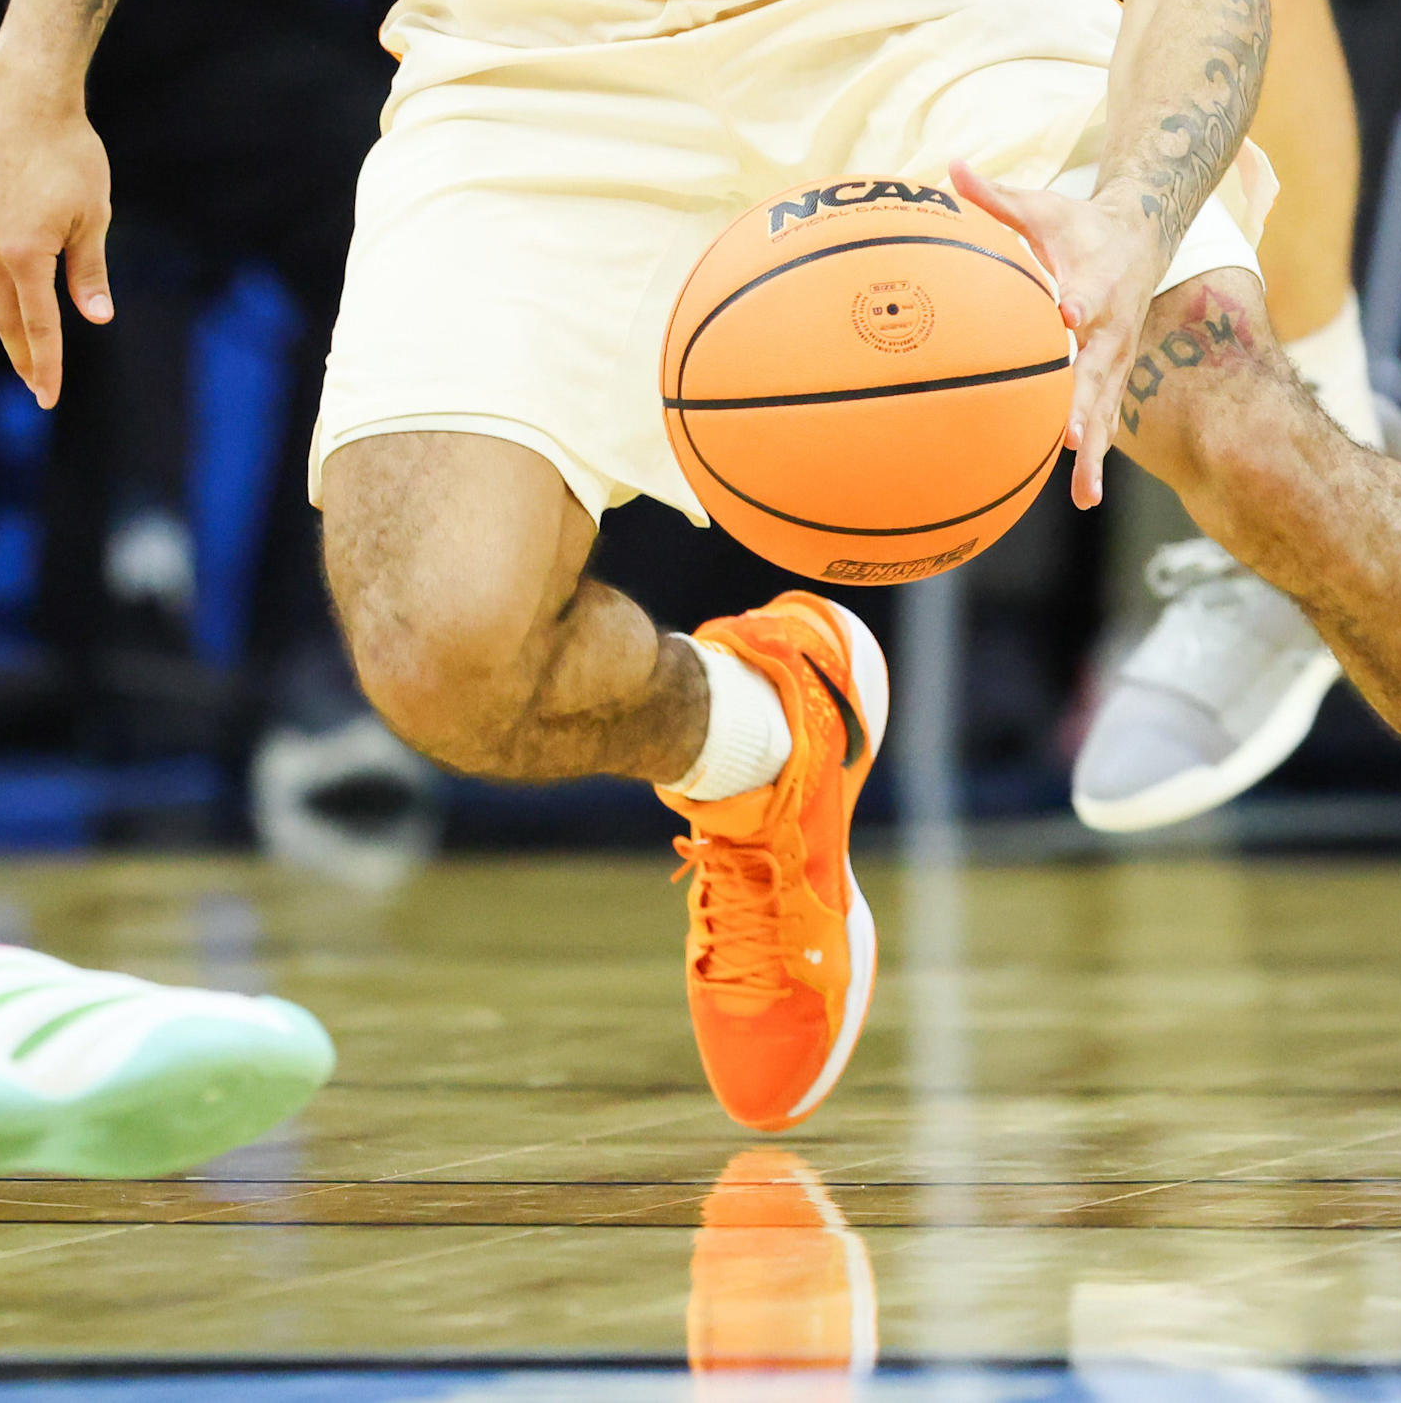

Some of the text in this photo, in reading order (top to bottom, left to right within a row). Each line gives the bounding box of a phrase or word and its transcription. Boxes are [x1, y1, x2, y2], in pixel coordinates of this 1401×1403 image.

[767, 181, 962, 235] NCAA
[771, 205, 966, 244] OFFICIAL GAME BALL
